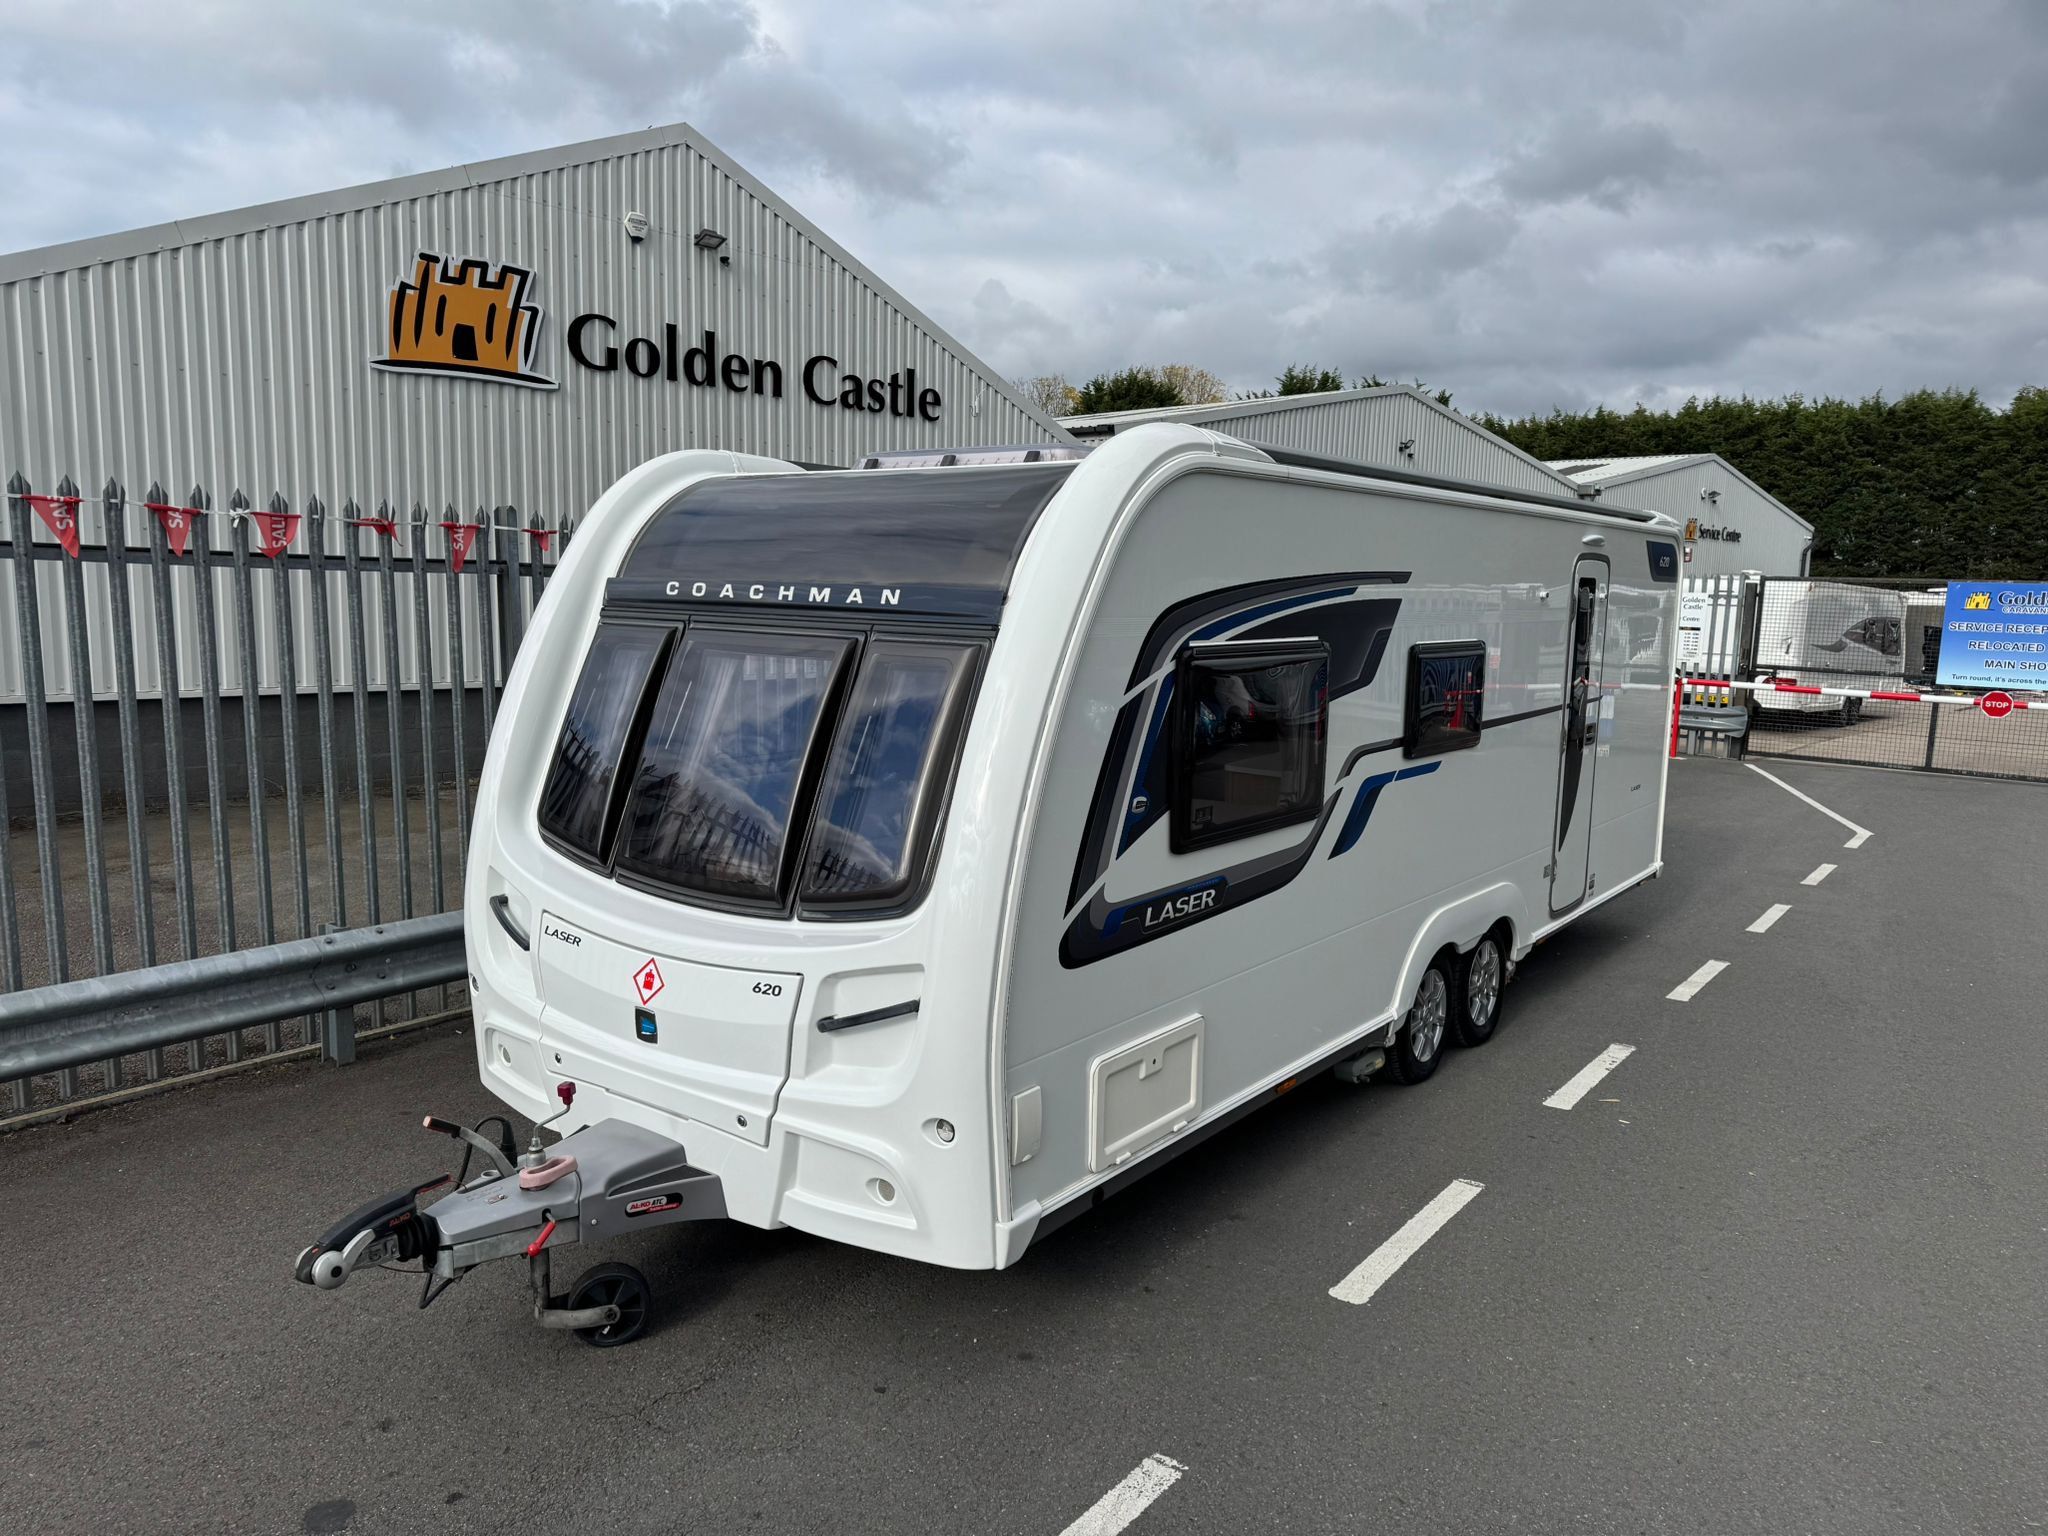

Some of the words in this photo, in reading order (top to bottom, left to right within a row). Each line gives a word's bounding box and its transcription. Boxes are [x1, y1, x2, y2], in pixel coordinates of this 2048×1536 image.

[567, 313, 783, 398] Golden
[803, 355, 942, 422] Castle
[1698, 523, 1721, 541] Service
[1722, 526, 1742, 543] Centre
[1659, 556, 1671, 568] 620
[666, 581, 901, 605] COACHMAN
[1997, 591, 2048, 607] Gold
[2002, 606, 2048, 614] CARAVAN
[1949, 622, 2003, 633] SERVICE
[1968, 641, 2045, 653] RELOCATED
[1984, 659, 2016, 670] MAIN
[2019, 661, 2048, 671] SHO
[1969, 675, 1993, 683] round,
[2035, 678, 2047, 686] the
[1985, 700, 2009, 708] STOP
[1144, 888, 1217, 927] LASER
[544, 925, 582, 947] LASER
[752, 981, 783, 997] 620
